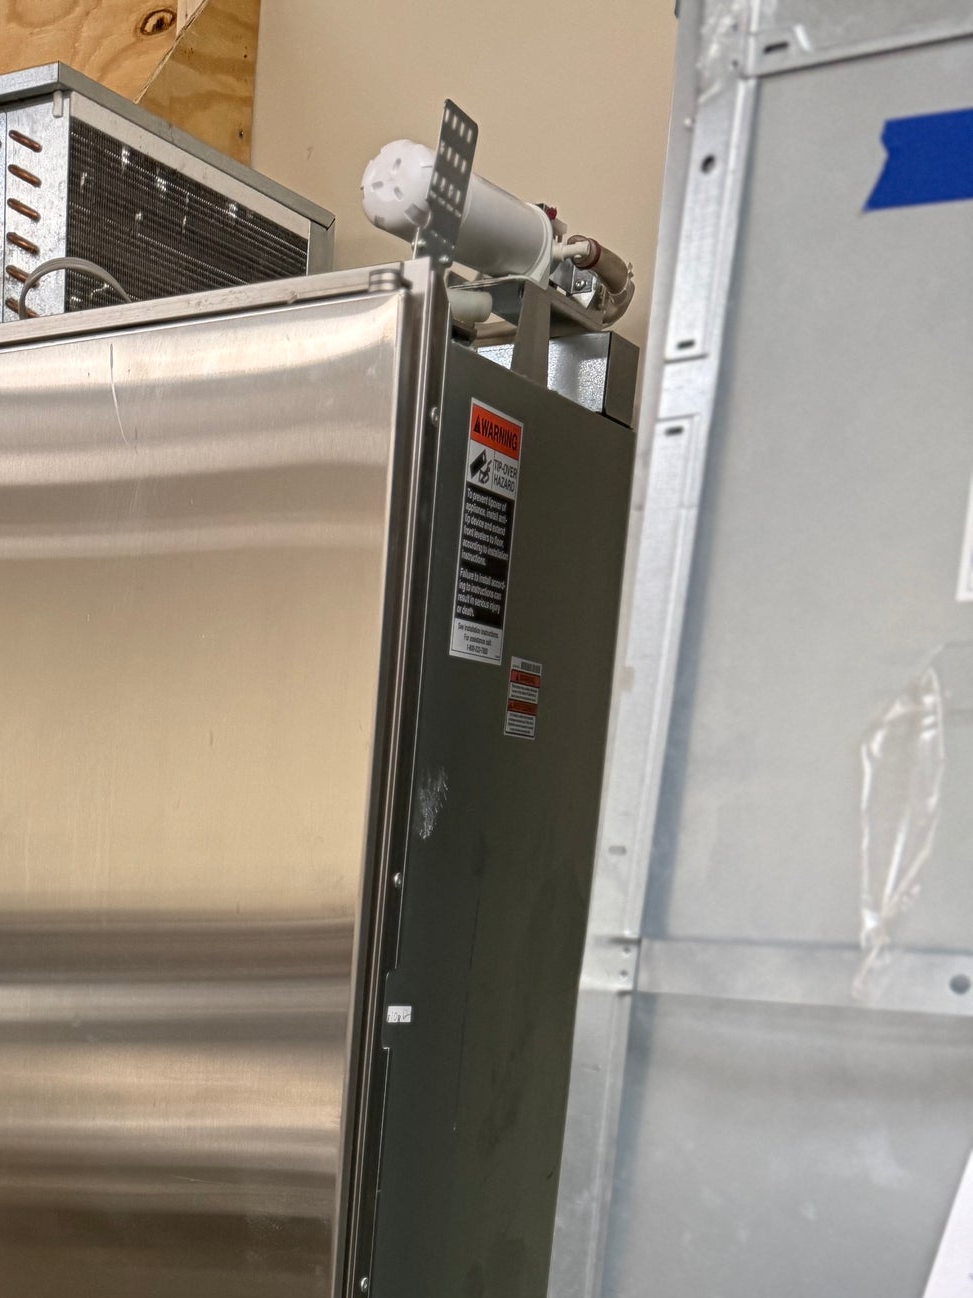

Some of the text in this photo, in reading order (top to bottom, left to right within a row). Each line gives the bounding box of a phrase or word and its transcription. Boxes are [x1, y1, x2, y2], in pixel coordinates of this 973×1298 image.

[481, 417, 517, 451] WARNING
[494, 459, 516, 479] TIP-OVER
[494, 473, 515, 492] HAZARD
[467, 488, 472, 498] To
[473, 492, 487, 506] prevent
[502, 501, 507, 512] of
[487, 508, 498, 521] install
[464, 525, 474, 537] front
[490, 535, 494, 544] to
[471, 515, 484, 528] device
[493, 524, 505, 536] extend
[462, 550, 486, 566] instructions.
[463, 537, 508, 561] according to installation
[460, 568, 474, 580] Failure
[479, 574, 491, 585] install
[466, 583, 470, 591] to
[471, 584, 494, 598] instructions
[458, 592, 500, 614] result in serious injury
[462, 606, 475, 617] death.
